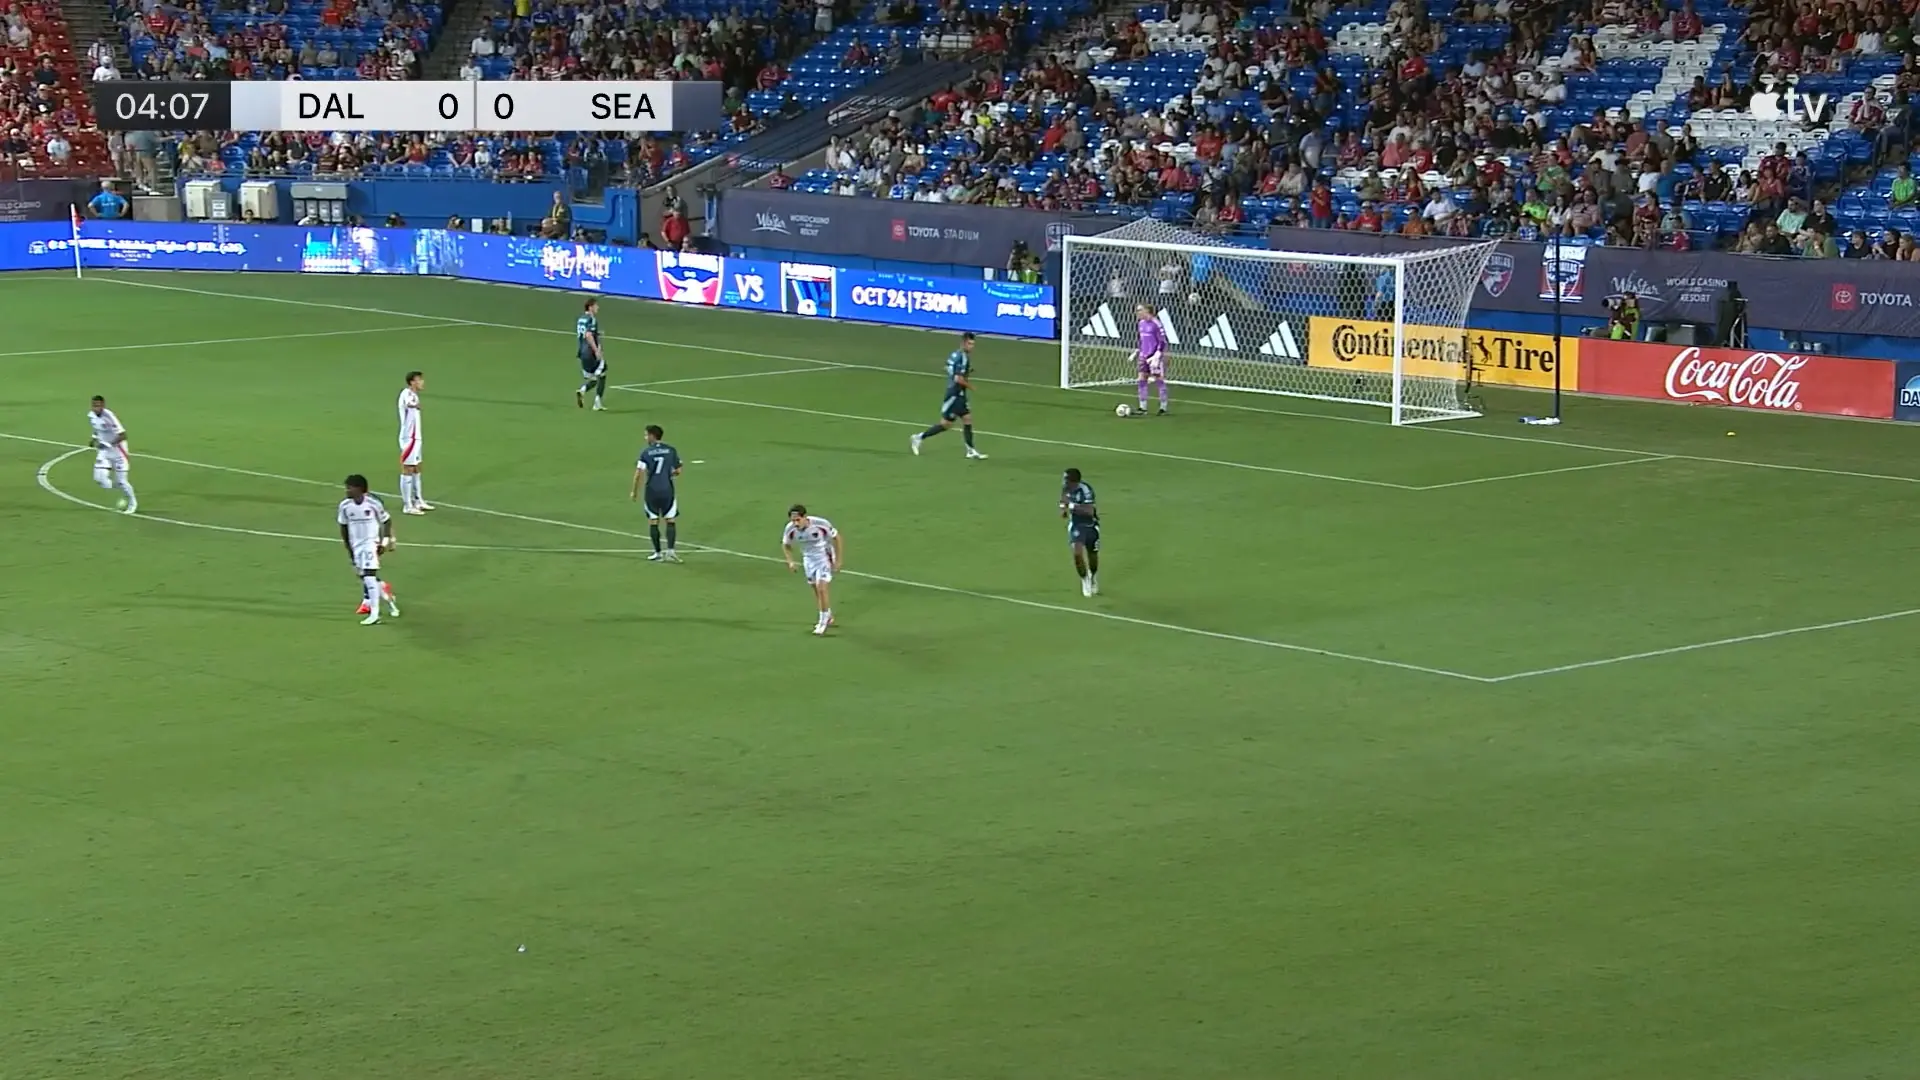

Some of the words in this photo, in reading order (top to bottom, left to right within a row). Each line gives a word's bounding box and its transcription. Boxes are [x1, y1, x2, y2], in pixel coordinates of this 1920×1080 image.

[908, 226, 940, 239] TOYOTA
[943, 228, 980, 241] STADIUM
[734, 273, 764, 303] VS
[1666, 278, 1696, 287] WORLD
[1697, 278, 1728, 288] CASINO
[852, 285, 886, 306] OCT
[887, 289, 908, 309] 24
[1680, 293, 1712, 303] RESORT
[1860, 291, 1912, 307] TOYOTA
[1492, 336, 1555, 373] Tire
[1665, 346, 1809, 409] Coca-Cola
[1900, 388, 1920, 407] DA
[653, 456, 664, 474] 7
